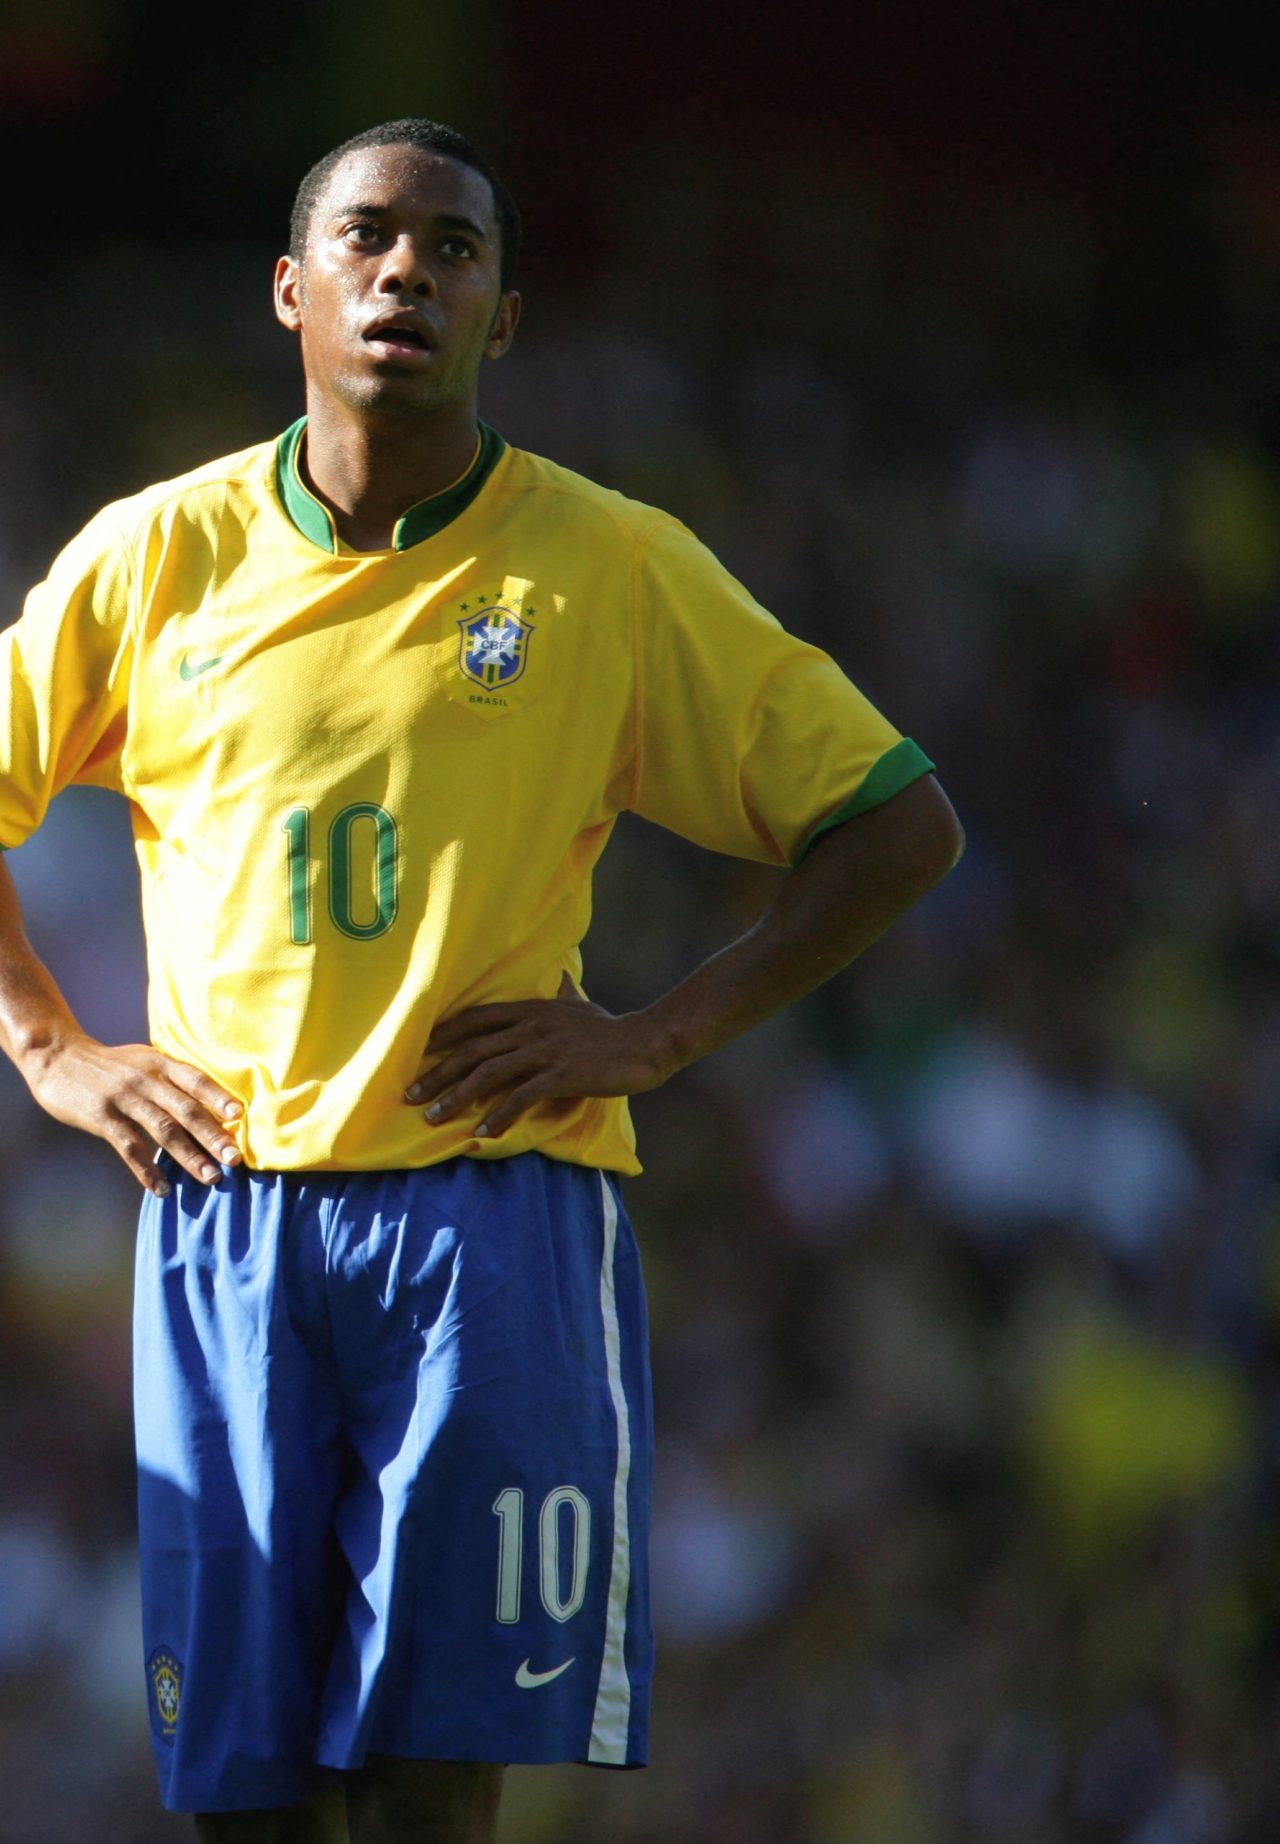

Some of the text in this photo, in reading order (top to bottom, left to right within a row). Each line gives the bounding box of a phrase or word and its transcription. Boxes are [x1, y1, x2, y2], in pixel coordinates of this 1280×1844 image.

[481, 639, 507, 650] CBF
[469, 695, 508, 707] BRASIL
[281, 802, 399, 945] 10
[492, 1485, 591, 1624] 10
